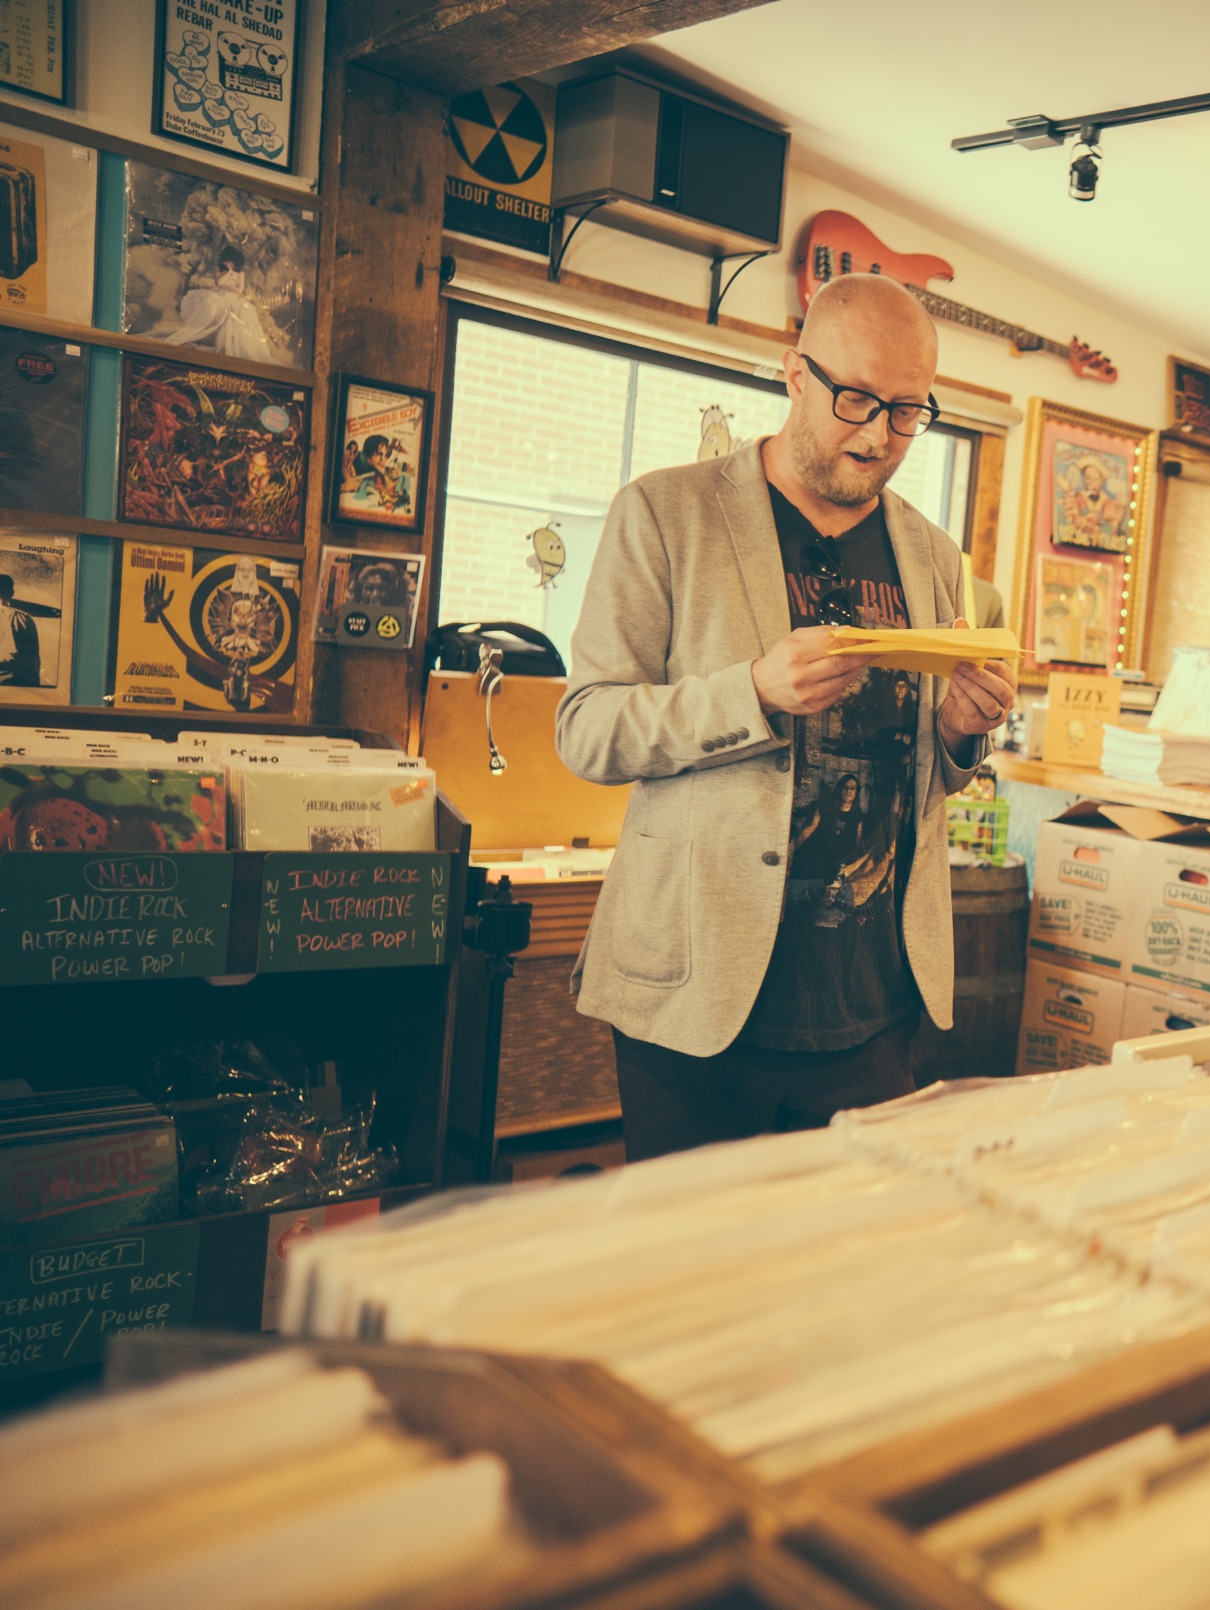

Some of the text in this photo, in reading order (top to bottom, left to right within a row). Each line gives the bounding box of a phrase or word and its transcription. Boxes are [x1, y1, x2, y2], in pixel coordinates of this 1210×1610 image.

[177, 6, 213, 31] REBAR
[217, 0, 283, 24] KE-UP
[224, 9, 238, 25] AL
[242, 16, 283, 41] SHEDAD
[169, 57, 188, 66] COOL
[182, 71, 203, 79] DREAM
[179, 94, 193, 102] OUT
[180, 88, 194, 98] FAR
[204, 89, 217, 97] BOY
[205, 85, 218, 93] BAD
[211, 103, 224, 112] HOT
[228, 95, 245, 106] STOP
[165, 121, 223, 144] Duke Coffeehouse
[166, 112, 225, 137] Friday February 23
[496, 194, 549, 223] SHELTER
[18, 358, 54, 372] FREE
[18, 543, 64, 555] Laughing
[131, 554, 185, 572] Ultimi Uomini
[1065, 687, 1107, 703] IZZY
[193, 739, 207, 747] S-T
[249, 756, 279, 764] M-N-O
[98, 861, 167, 887] NEW!
[288, 866, 421, 891] INDIE ROCK
[46, 894, 188, 922] INDIE ROCK
[300, 894, 416, 924] ALTERNATIVE
[1041, 898, 1071, 910] SAVE!
[1151, 921, 1178, 935] 100%
[21, 927, 215, 951] ALTERNATIVE ROCK
[295, 929, 416, 954] POWER POP!
[51, 951, 185, 980] POWER POP!
[37, 1242, 137, 1278] BUDGET
[0, 1271, 183, 1316] ERNATIVE ROCK
[100, 1303, 171, 1332] POWER
